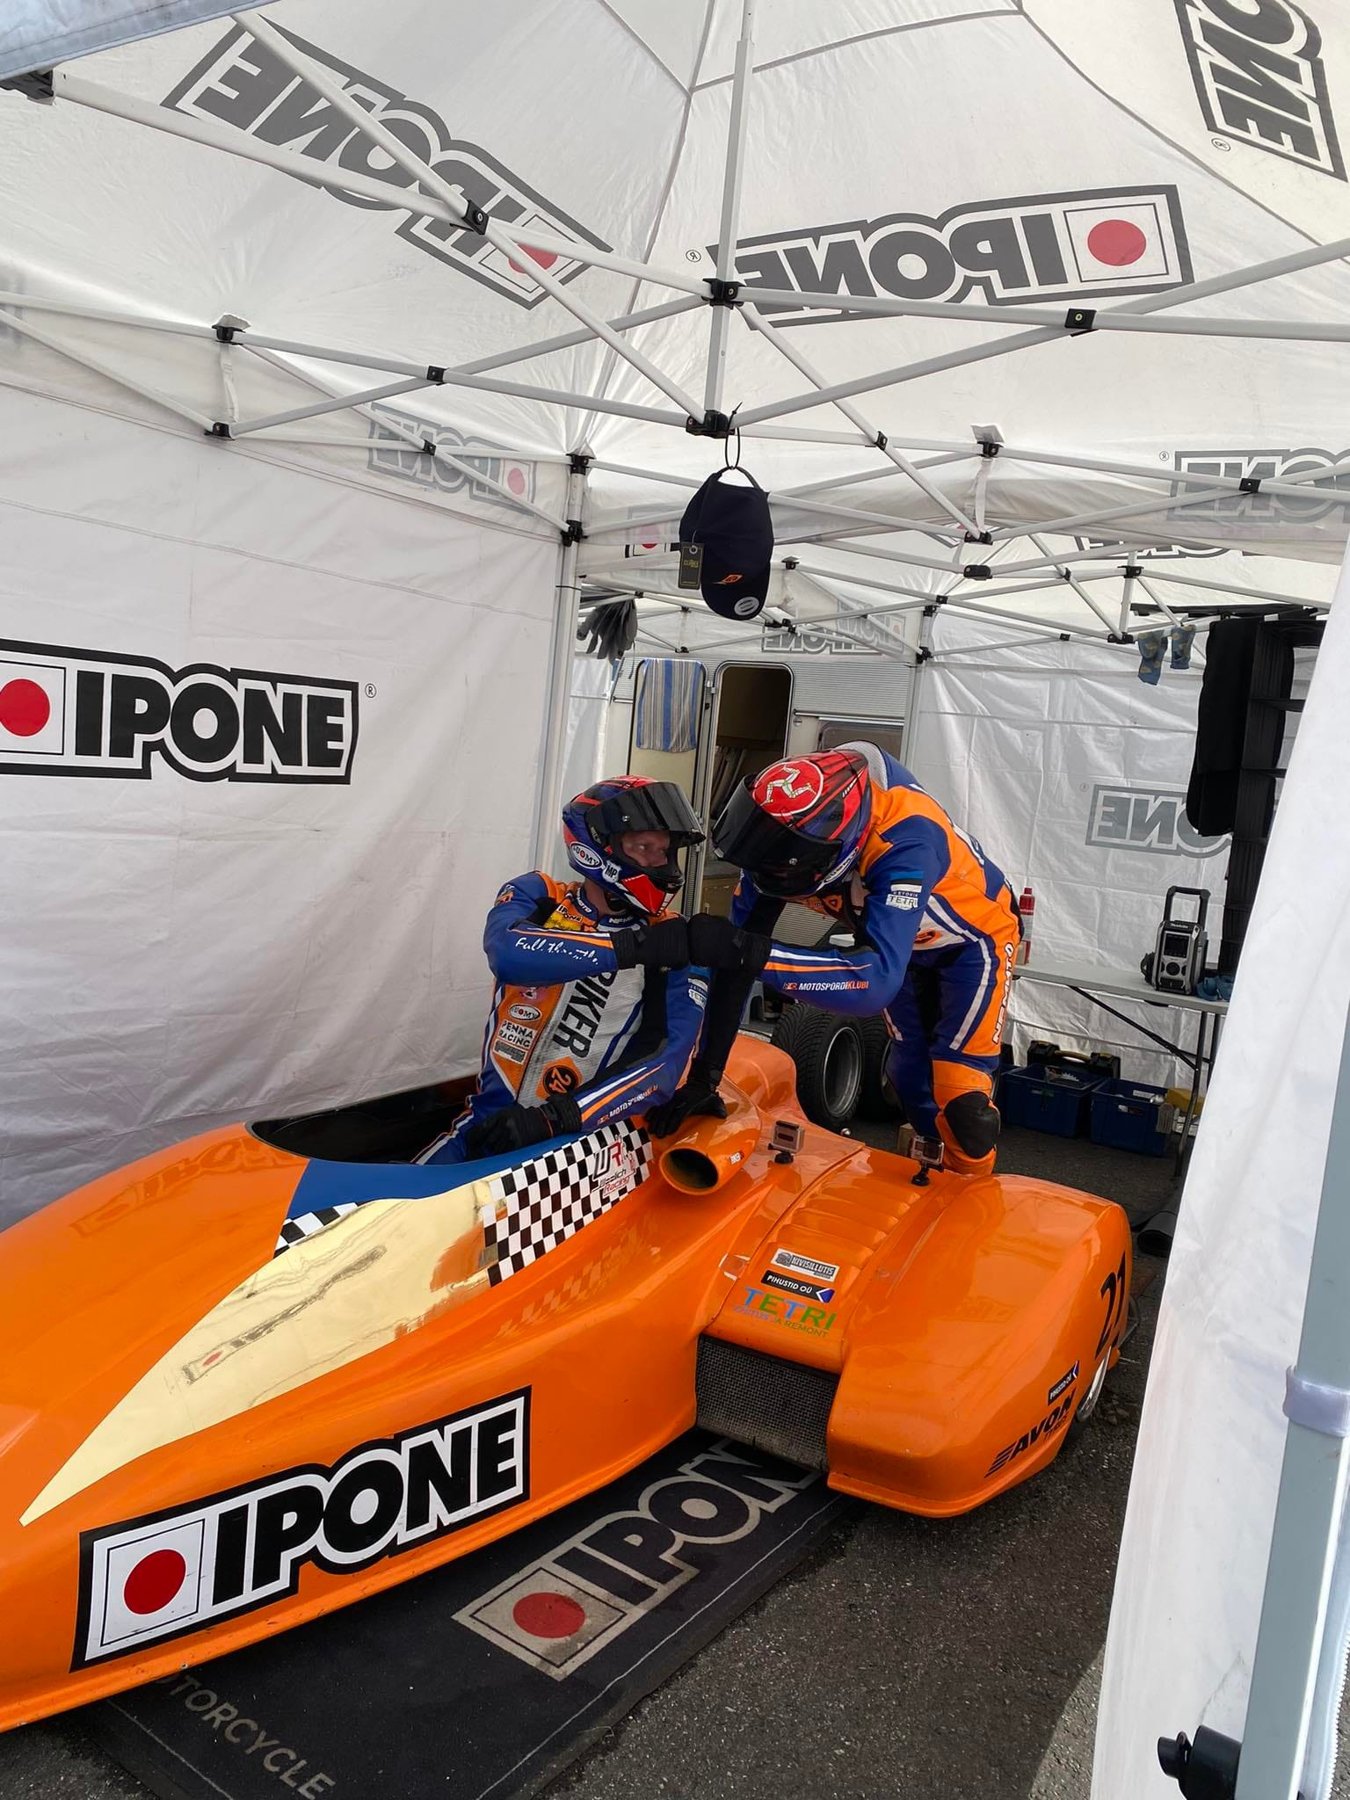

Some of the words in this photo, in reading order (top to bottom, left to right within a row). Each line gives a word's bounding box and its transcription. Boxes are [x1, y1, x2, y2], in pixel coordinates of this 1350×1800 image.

[75, 670, 345, 767] IPONE
[890, 895, 917, 906] TETRI
[549, 1067, 572, 1093] 24
[767, 1275, 799, 1290] PIHUSTID
[745, 1286, 837, 1330] TETRI
[784, 1320, 829, 1338] REMONT
[1008, 1387, 1077, 1461] AVON
[212, 1408, 517, 1606] IPONE
